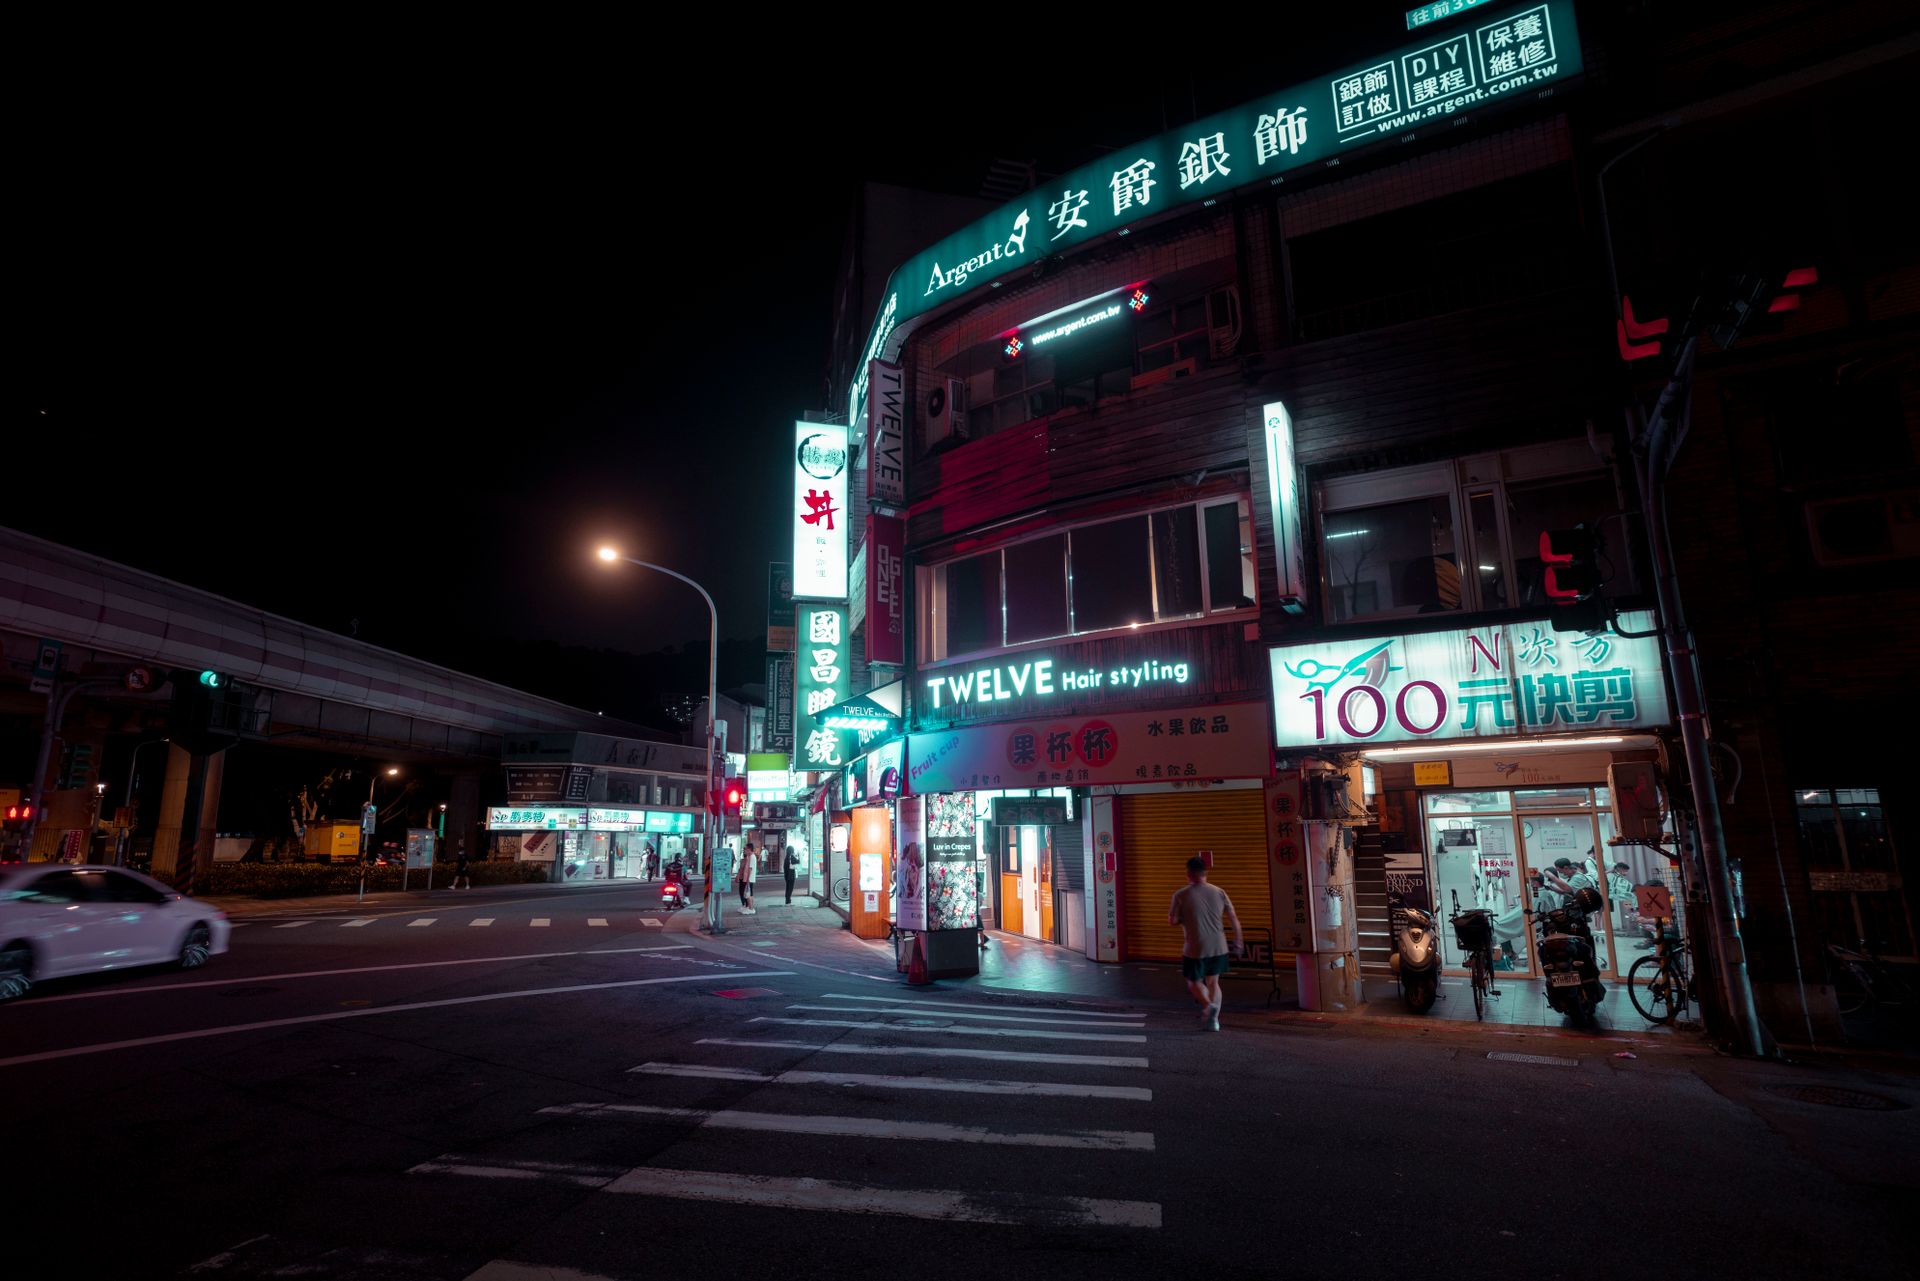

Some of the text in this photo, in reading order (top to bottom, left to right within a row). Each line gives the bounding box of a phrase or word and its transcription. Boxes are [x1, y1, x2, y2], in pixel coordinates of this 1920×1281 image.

[1486, 14, 1543, 52] 保養
[1412, 44, 1459, 78] DIY
[1489, 38, 1548, 78] 維修
[1338, 69, 1389, 103] 銀飾
[1377, 63, 1559, 134] www.argent.com.tw
[1413, 69, 1467, 103] 課程
[1342, 92, 1393, 126] 訂做
[1048, 105, 1309, 242] 安爵銀飾
[923, 243, 1003, 297] Argent
[1031, 304, 1121, 346] www.argent.com.tw
[881, 373, 902, 483] TWELVE
[877, 544, 889, 603] ONE
[804, 610, 842, 766] 國昌眼鏡
[927, 659, 1189, 709] TWELVE Hair styling
[842, 705, 875, 717] TWELVE
[1147, 715, 1231, 737] 水果飲品
[911, 752, 938, 780] Fruit
[940, 736, 960, 756] cup
[1012, 726, 1112, 765] 果杯杯
